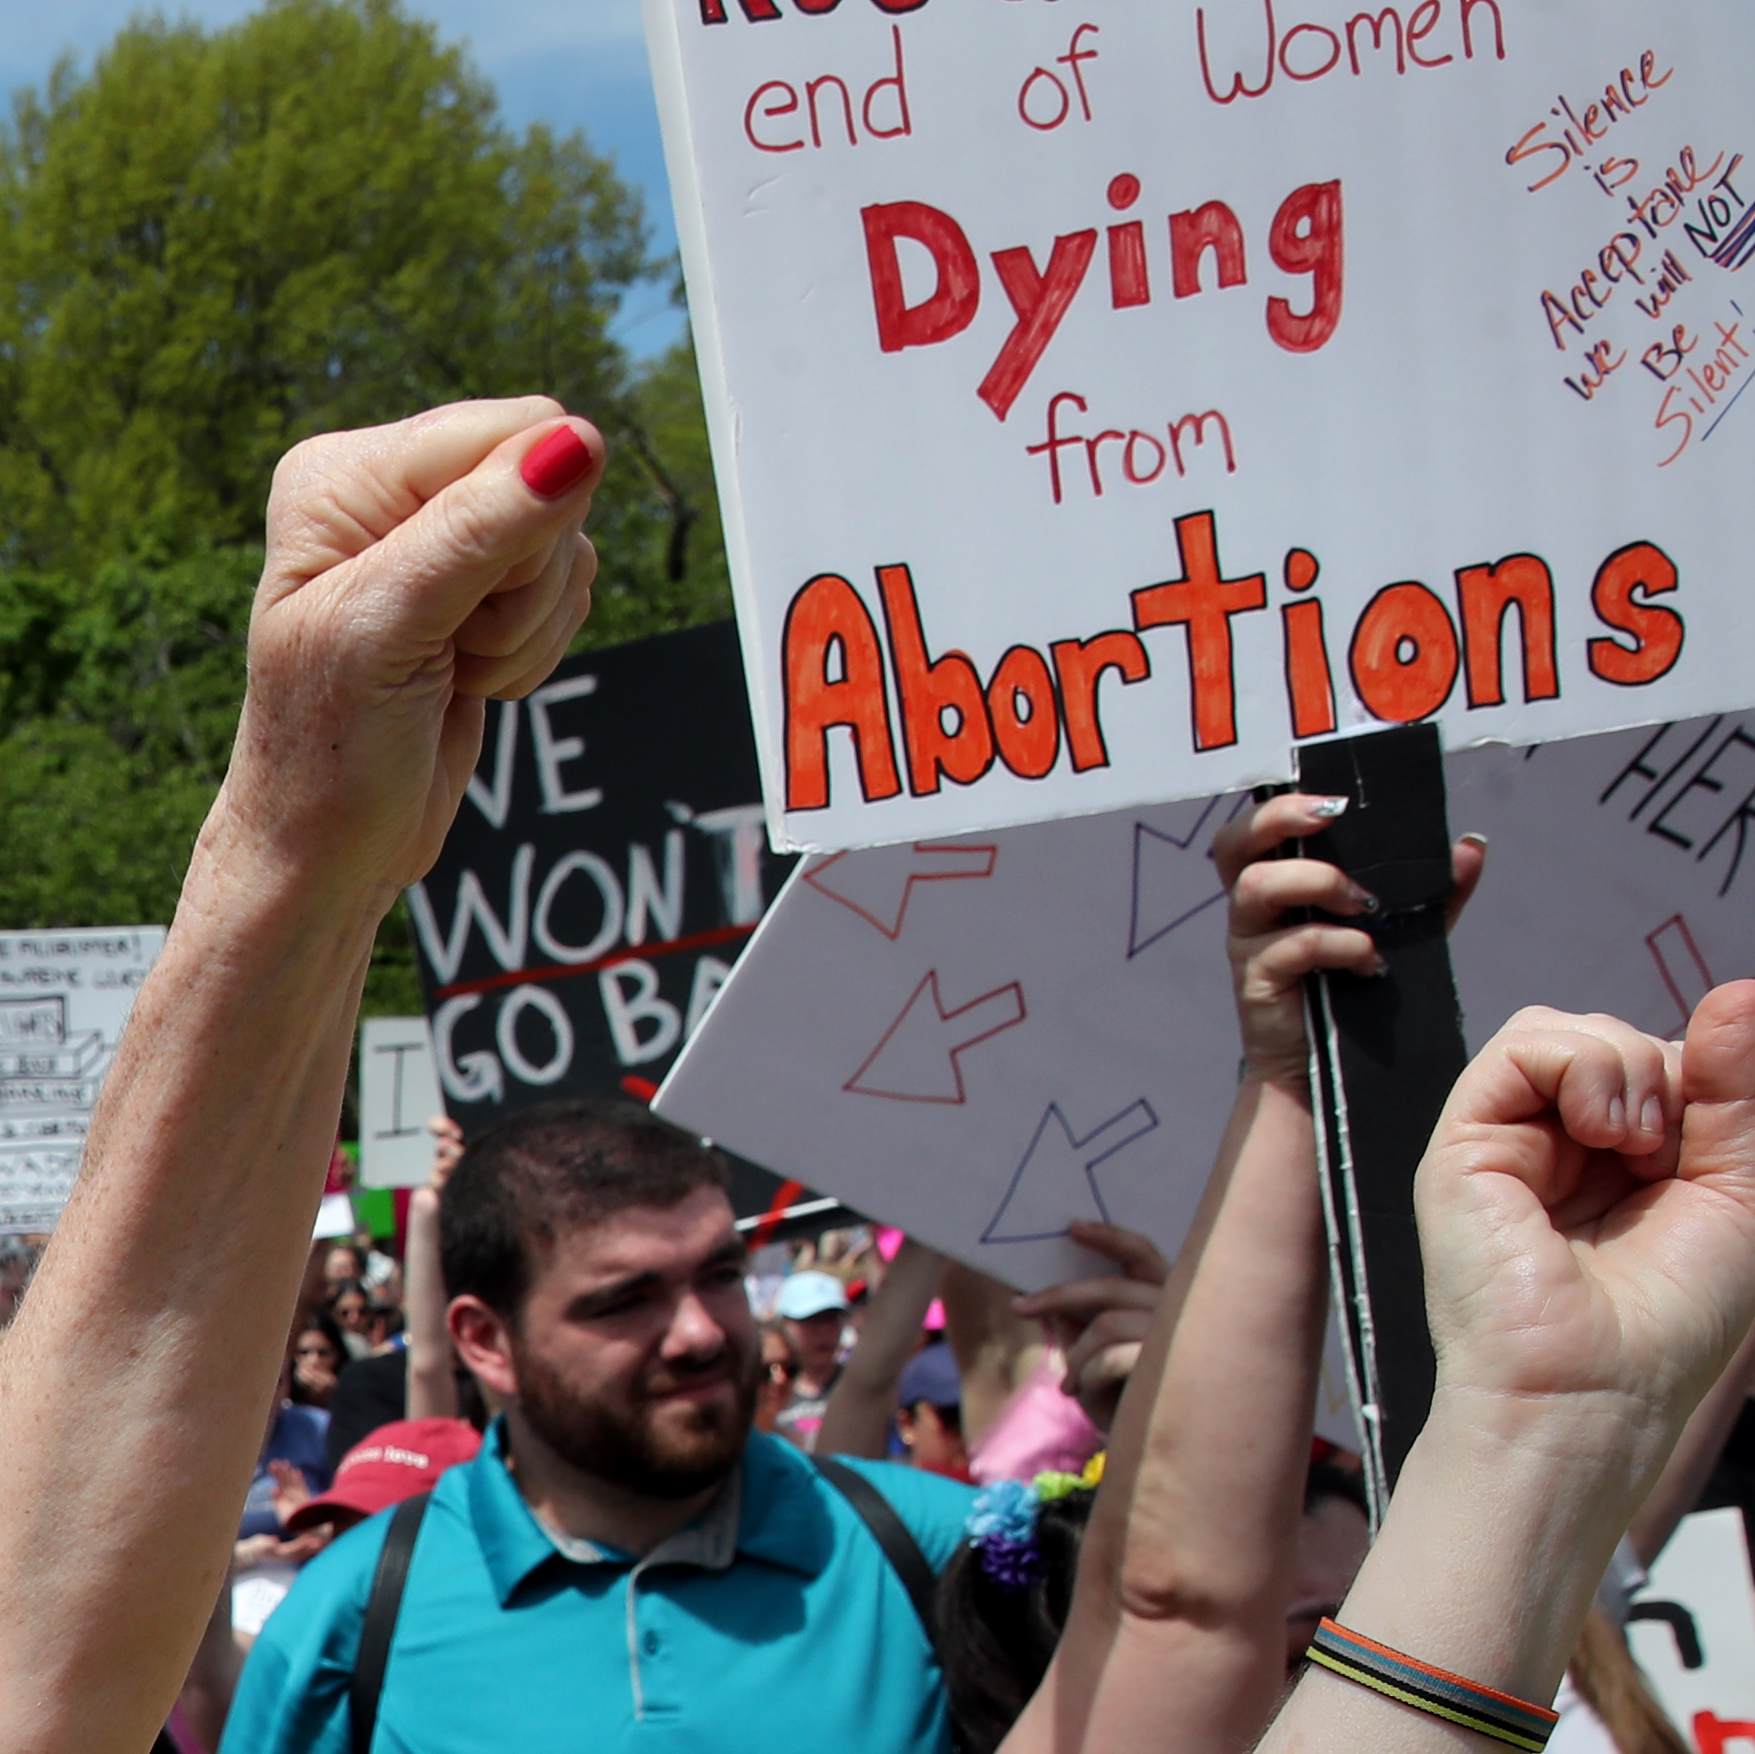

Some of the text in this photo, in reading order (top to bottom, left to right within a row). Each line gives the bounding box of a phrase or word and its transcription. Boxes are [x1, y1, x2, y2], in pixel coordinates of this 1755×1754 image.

[745, 0, 1506, 152] end of Women
[1506, 50, 1673, 192] Silence
[1584, 157, 1639, 196] is
[1635, 249, 1693, 319] will
[1684, 153, 1744, 258] NOT
[860, 172, 1343, 422] Dying
[1641, 324, 1698, 381] Be
[1026, 391, 1237, 504] from
[782, 509, 1686, 811] Abortions
[407, 802, 768, 985] WON'T
[373, 1044, 424, 1140] I
[433, 955, 729, 1100] GO BA
